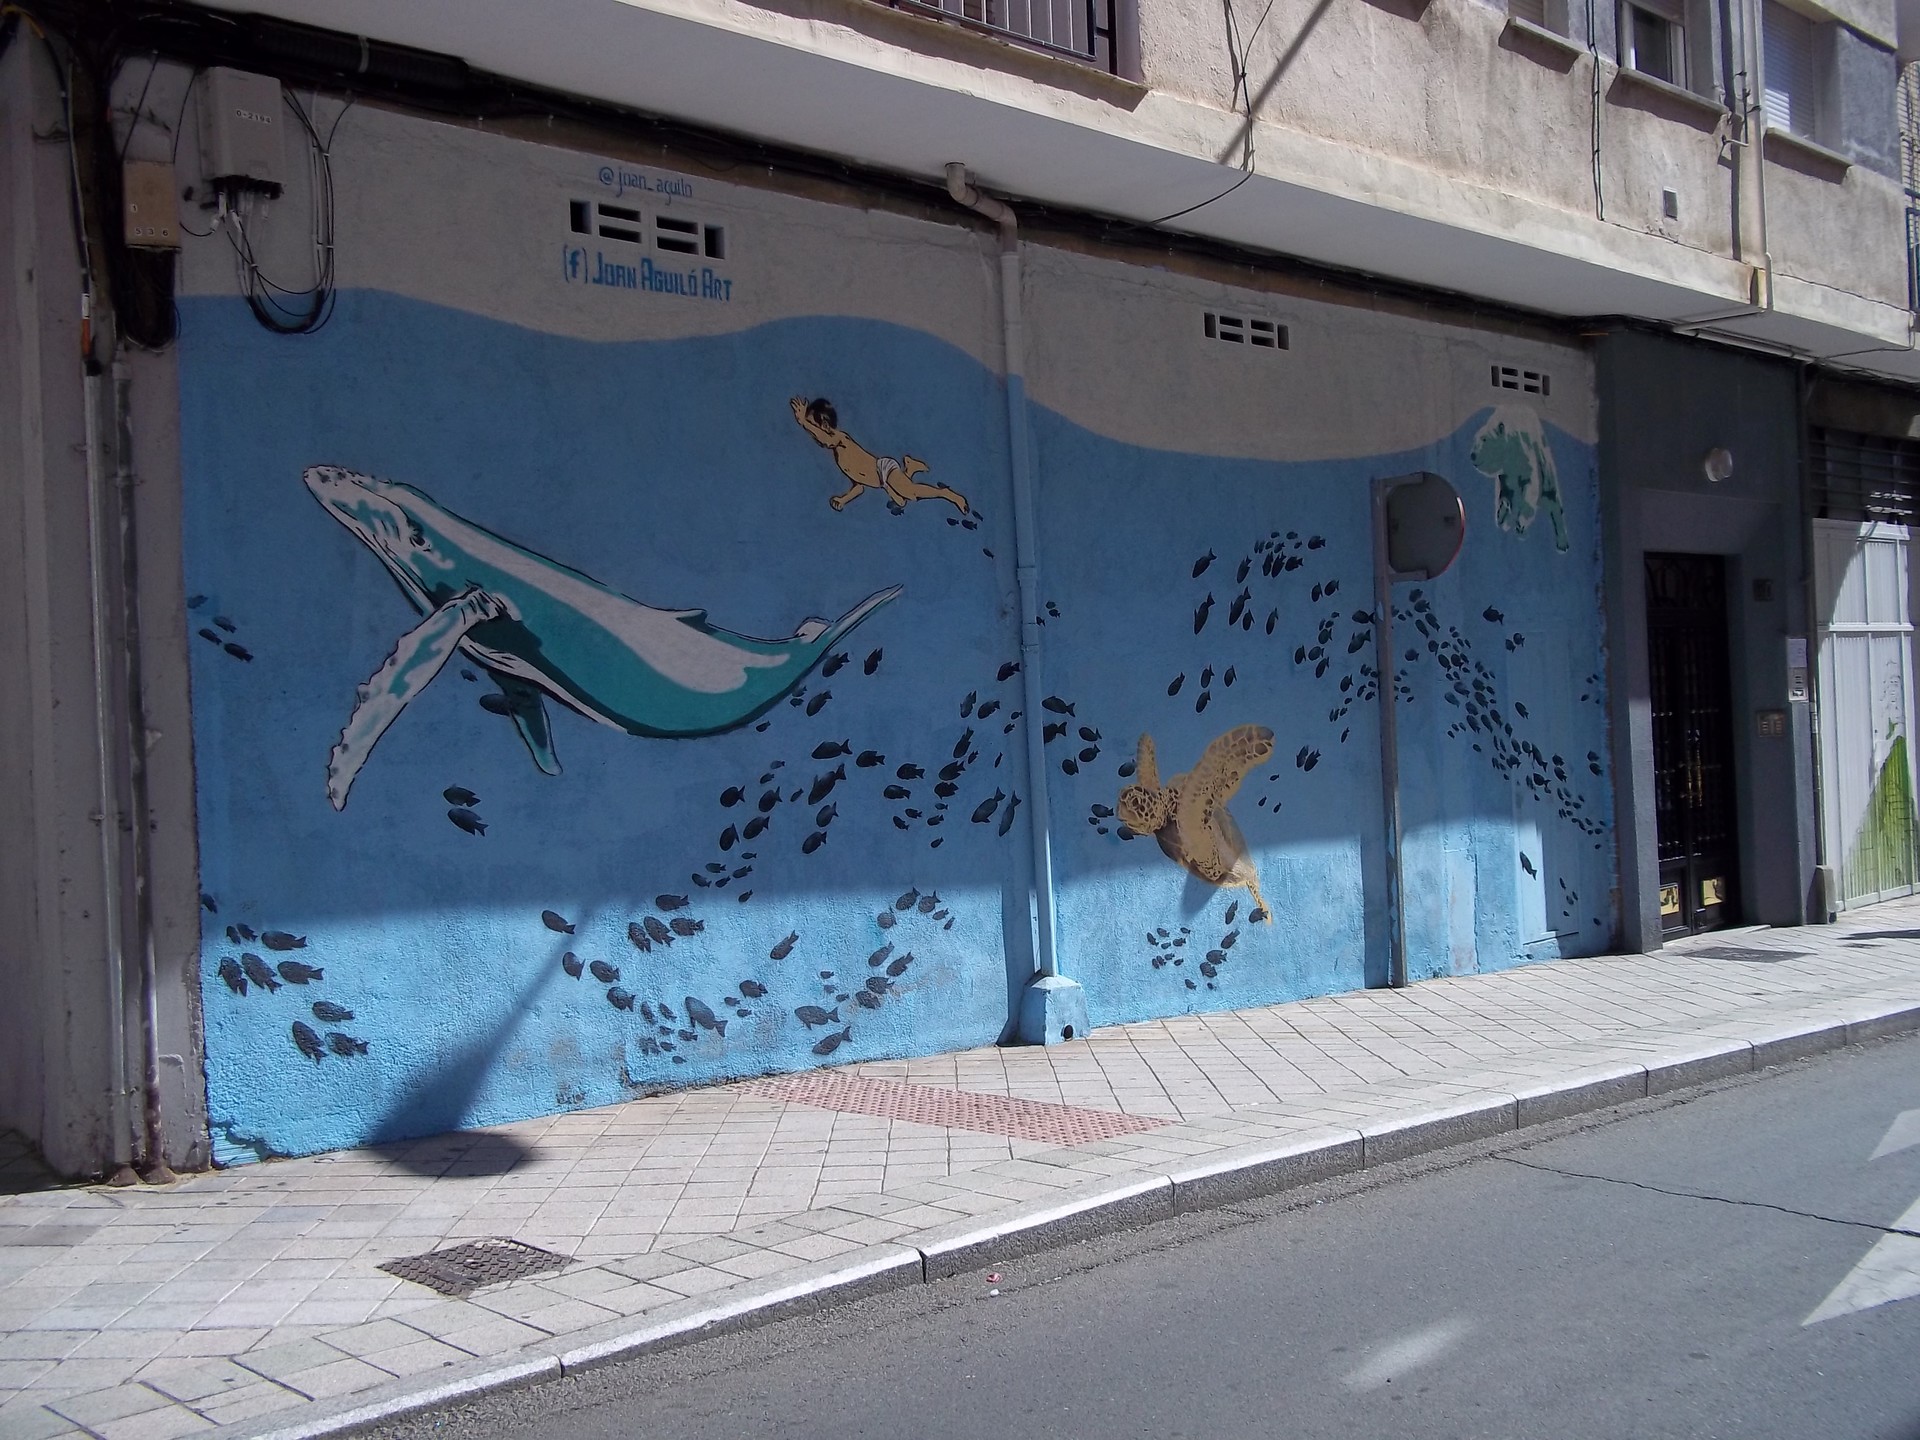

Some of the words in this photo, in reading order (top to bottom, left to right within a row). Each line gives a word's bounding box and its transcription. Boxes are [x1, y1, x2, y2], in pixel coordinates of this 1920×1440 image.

[592, 252, 636, 289] JOAN
[640, 257, 698, 297] AGUILÓ
[702, 268, 733, 301] ART
